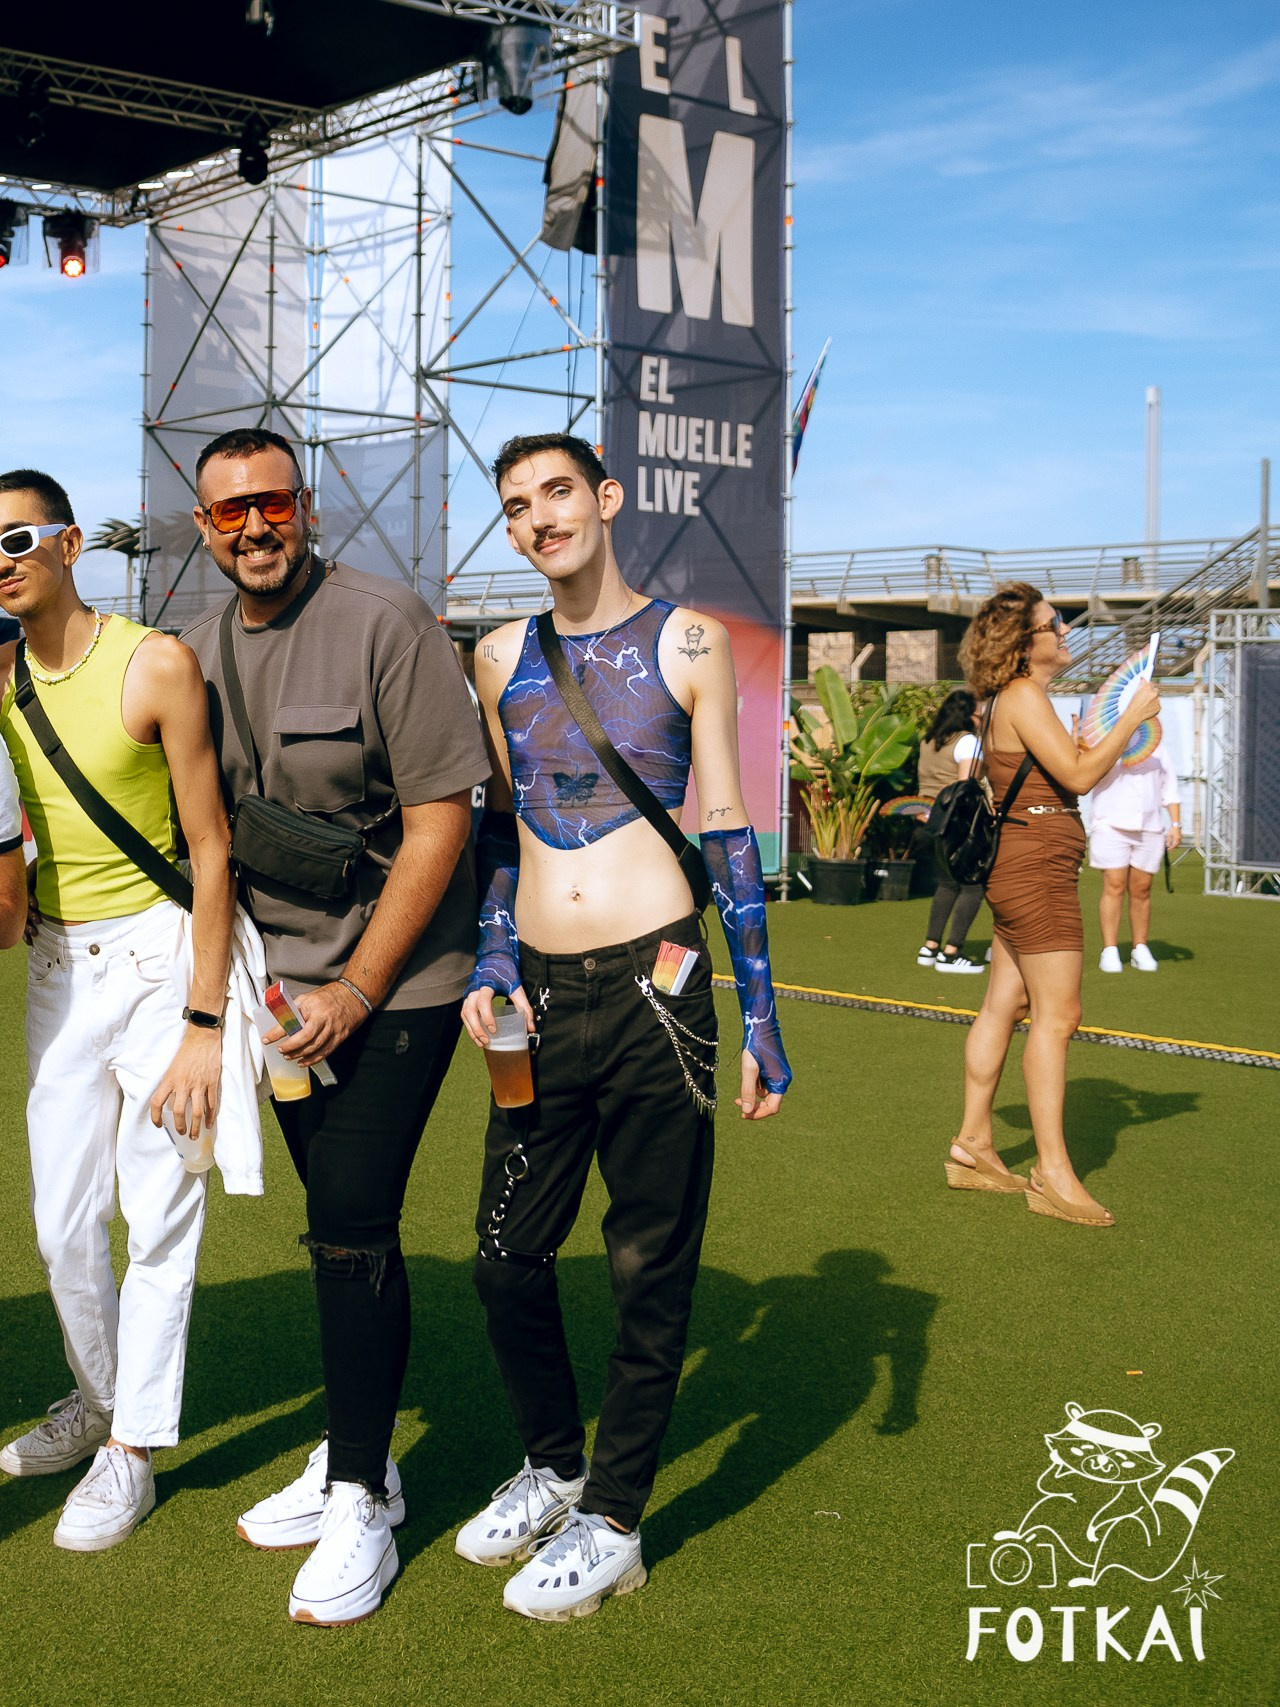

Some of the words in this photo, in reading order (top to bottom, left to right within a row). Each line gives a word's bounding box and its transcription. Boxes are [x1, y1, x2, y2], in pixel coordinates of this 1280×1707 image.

[639, 13, 672, 94] E
[726, 36, 758, 116] L
[636, 113, 756, 328] M
[639, 355, 674, 404] EL
[638, 411, 753, 469] MUELLE
[637, 465, 701, 517] LIVE
